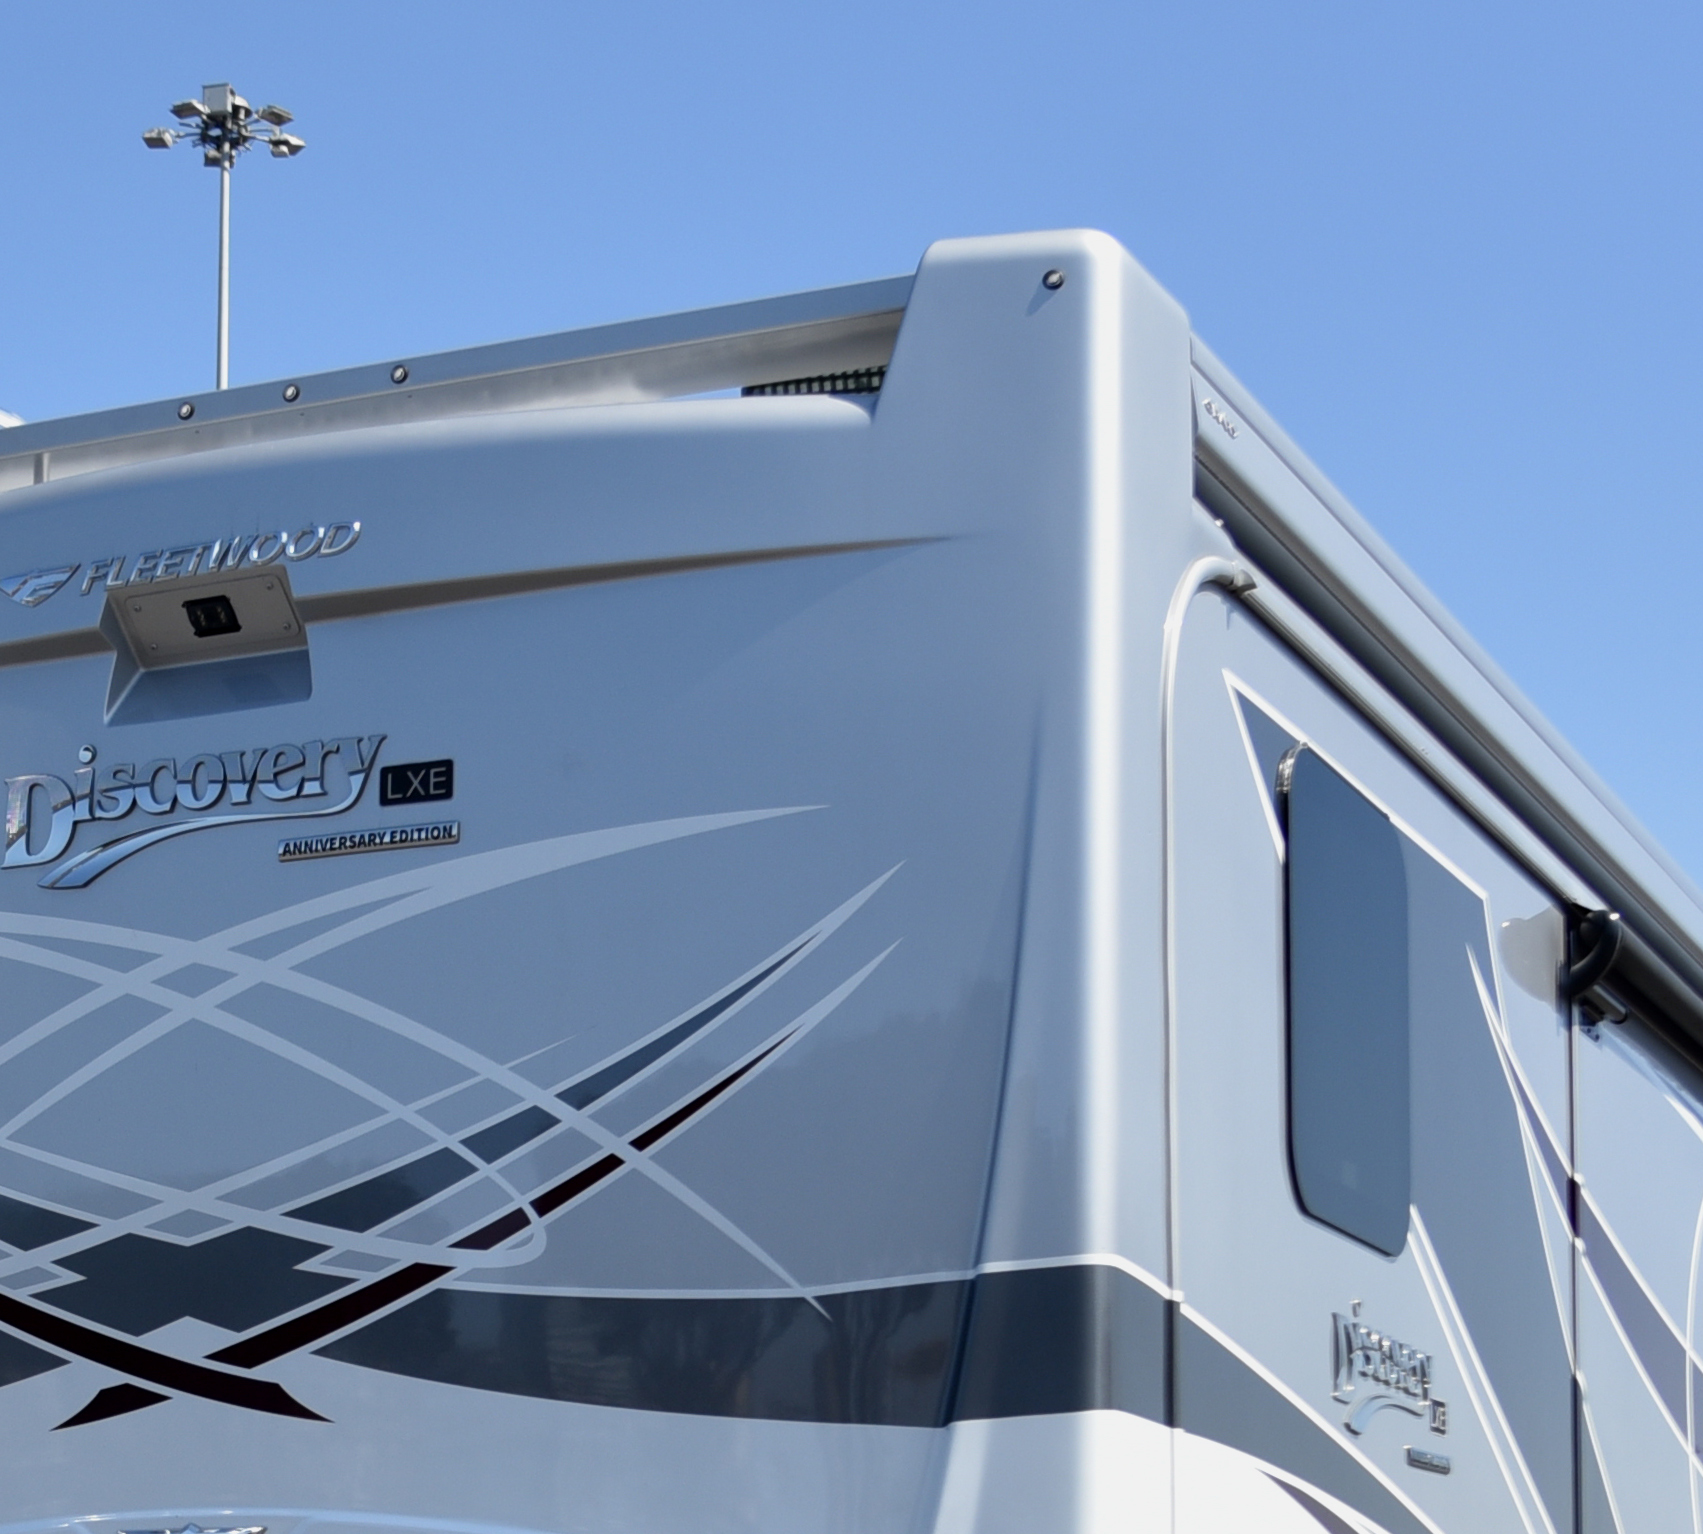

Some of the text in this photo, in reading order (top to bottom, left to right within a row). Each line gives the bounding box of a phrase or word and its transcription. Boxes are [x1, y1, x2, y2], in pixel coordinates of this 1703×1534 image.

[79, 521, 362, 597] FLEETWOOD
[0, 734, 448, 889] Discovery LXE
[282, 824, 455, 857] ANNIVERSARY EDITION
